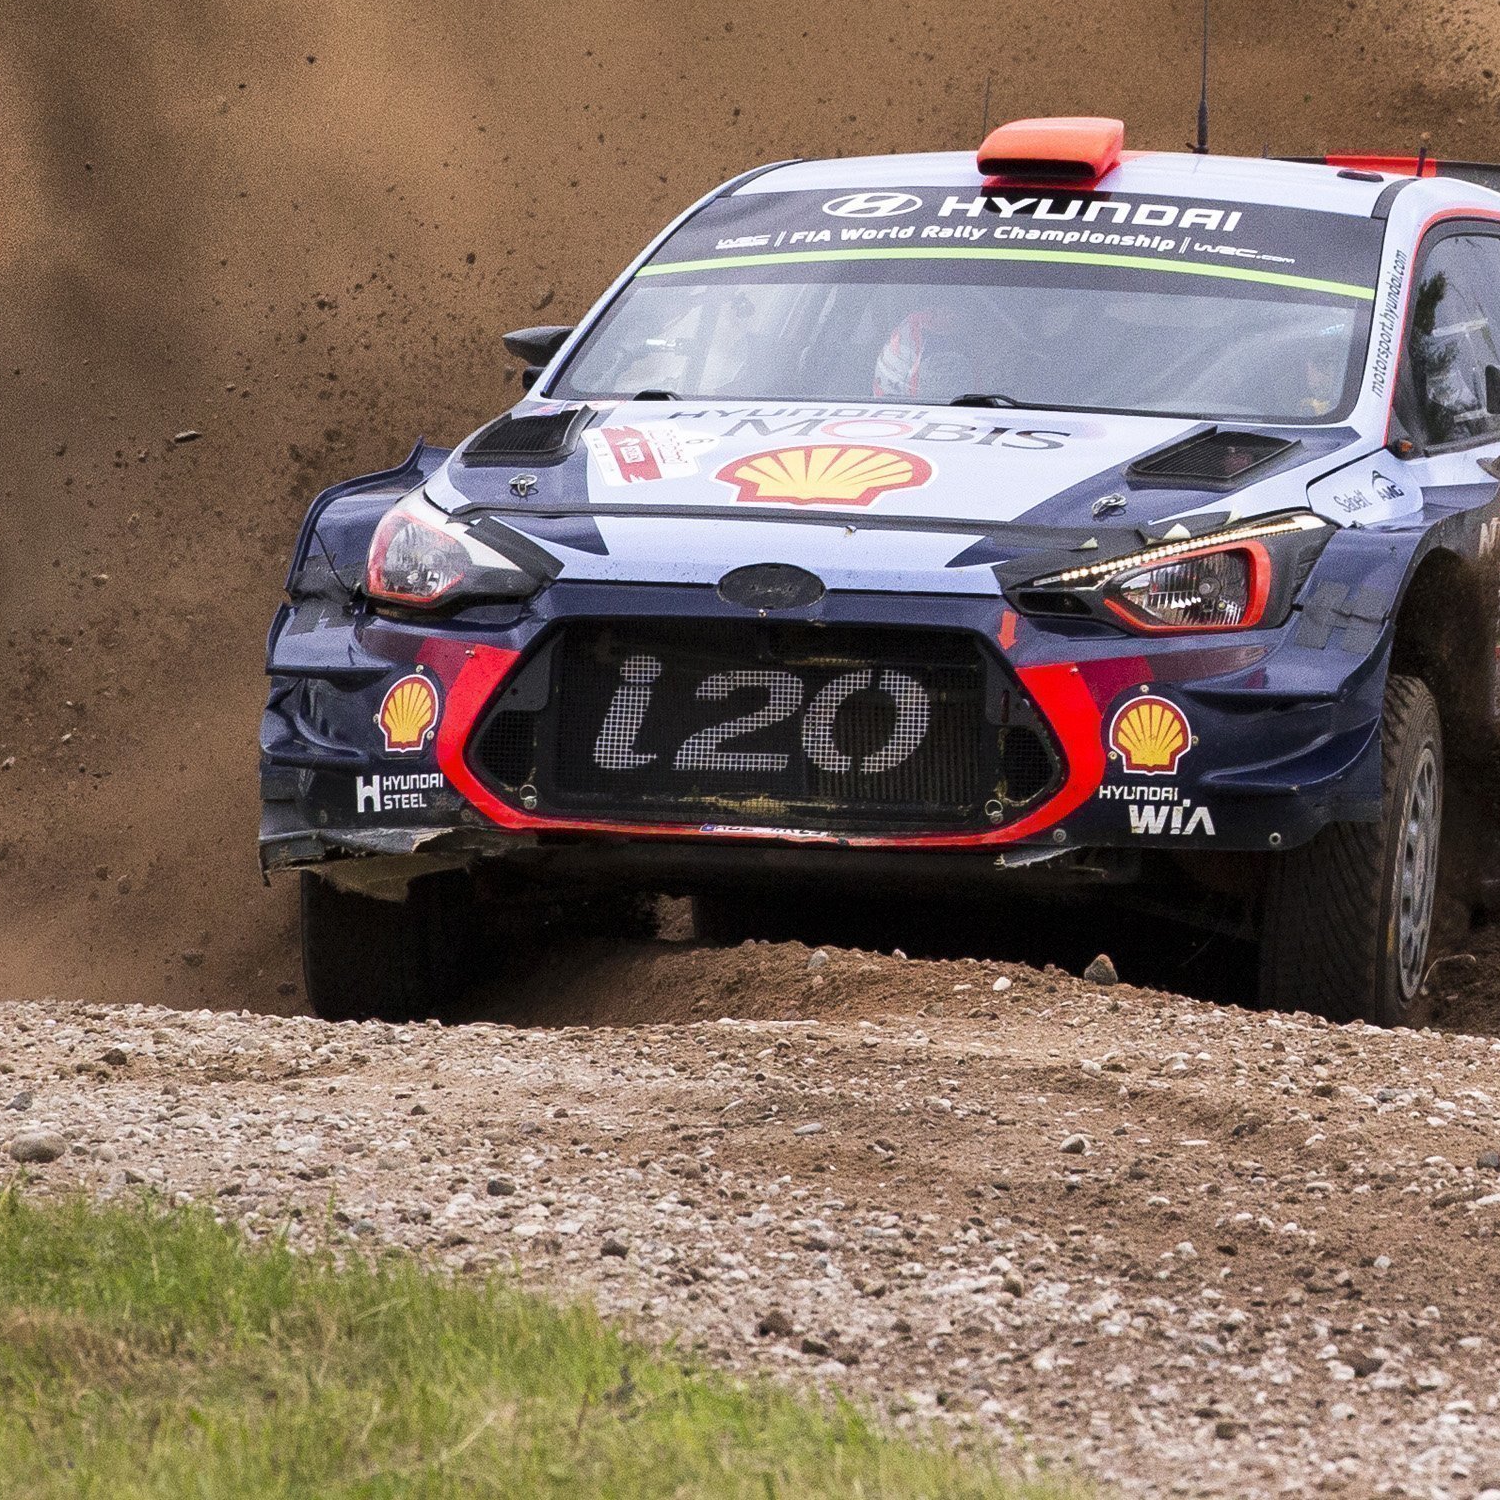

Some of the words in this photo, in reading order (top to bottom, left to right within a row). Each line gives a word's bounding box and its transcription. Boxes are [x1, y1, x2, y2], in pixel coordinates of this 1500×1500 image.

[937, 195, 1242, 232] HYUNDAI
[790, 229, 831, 244] FIA
[841, 225, 915, 241] World
[921, 225, 988, 241] Rally
[994, 226, 1176, 252] Championship
[1371, 249, 1408, 398] motorsport.hyundai.com
[667, 407, 929, 420] HYUNDAI
[720, 418, 1072, 451] MOBIS
[593, 654, 931, 774] i20
[382, 772, 444, 791] HYUNDAI
[1098, 785, 1179, 801] HYUNDAI
[383, 792, 427, 810] STEEL
